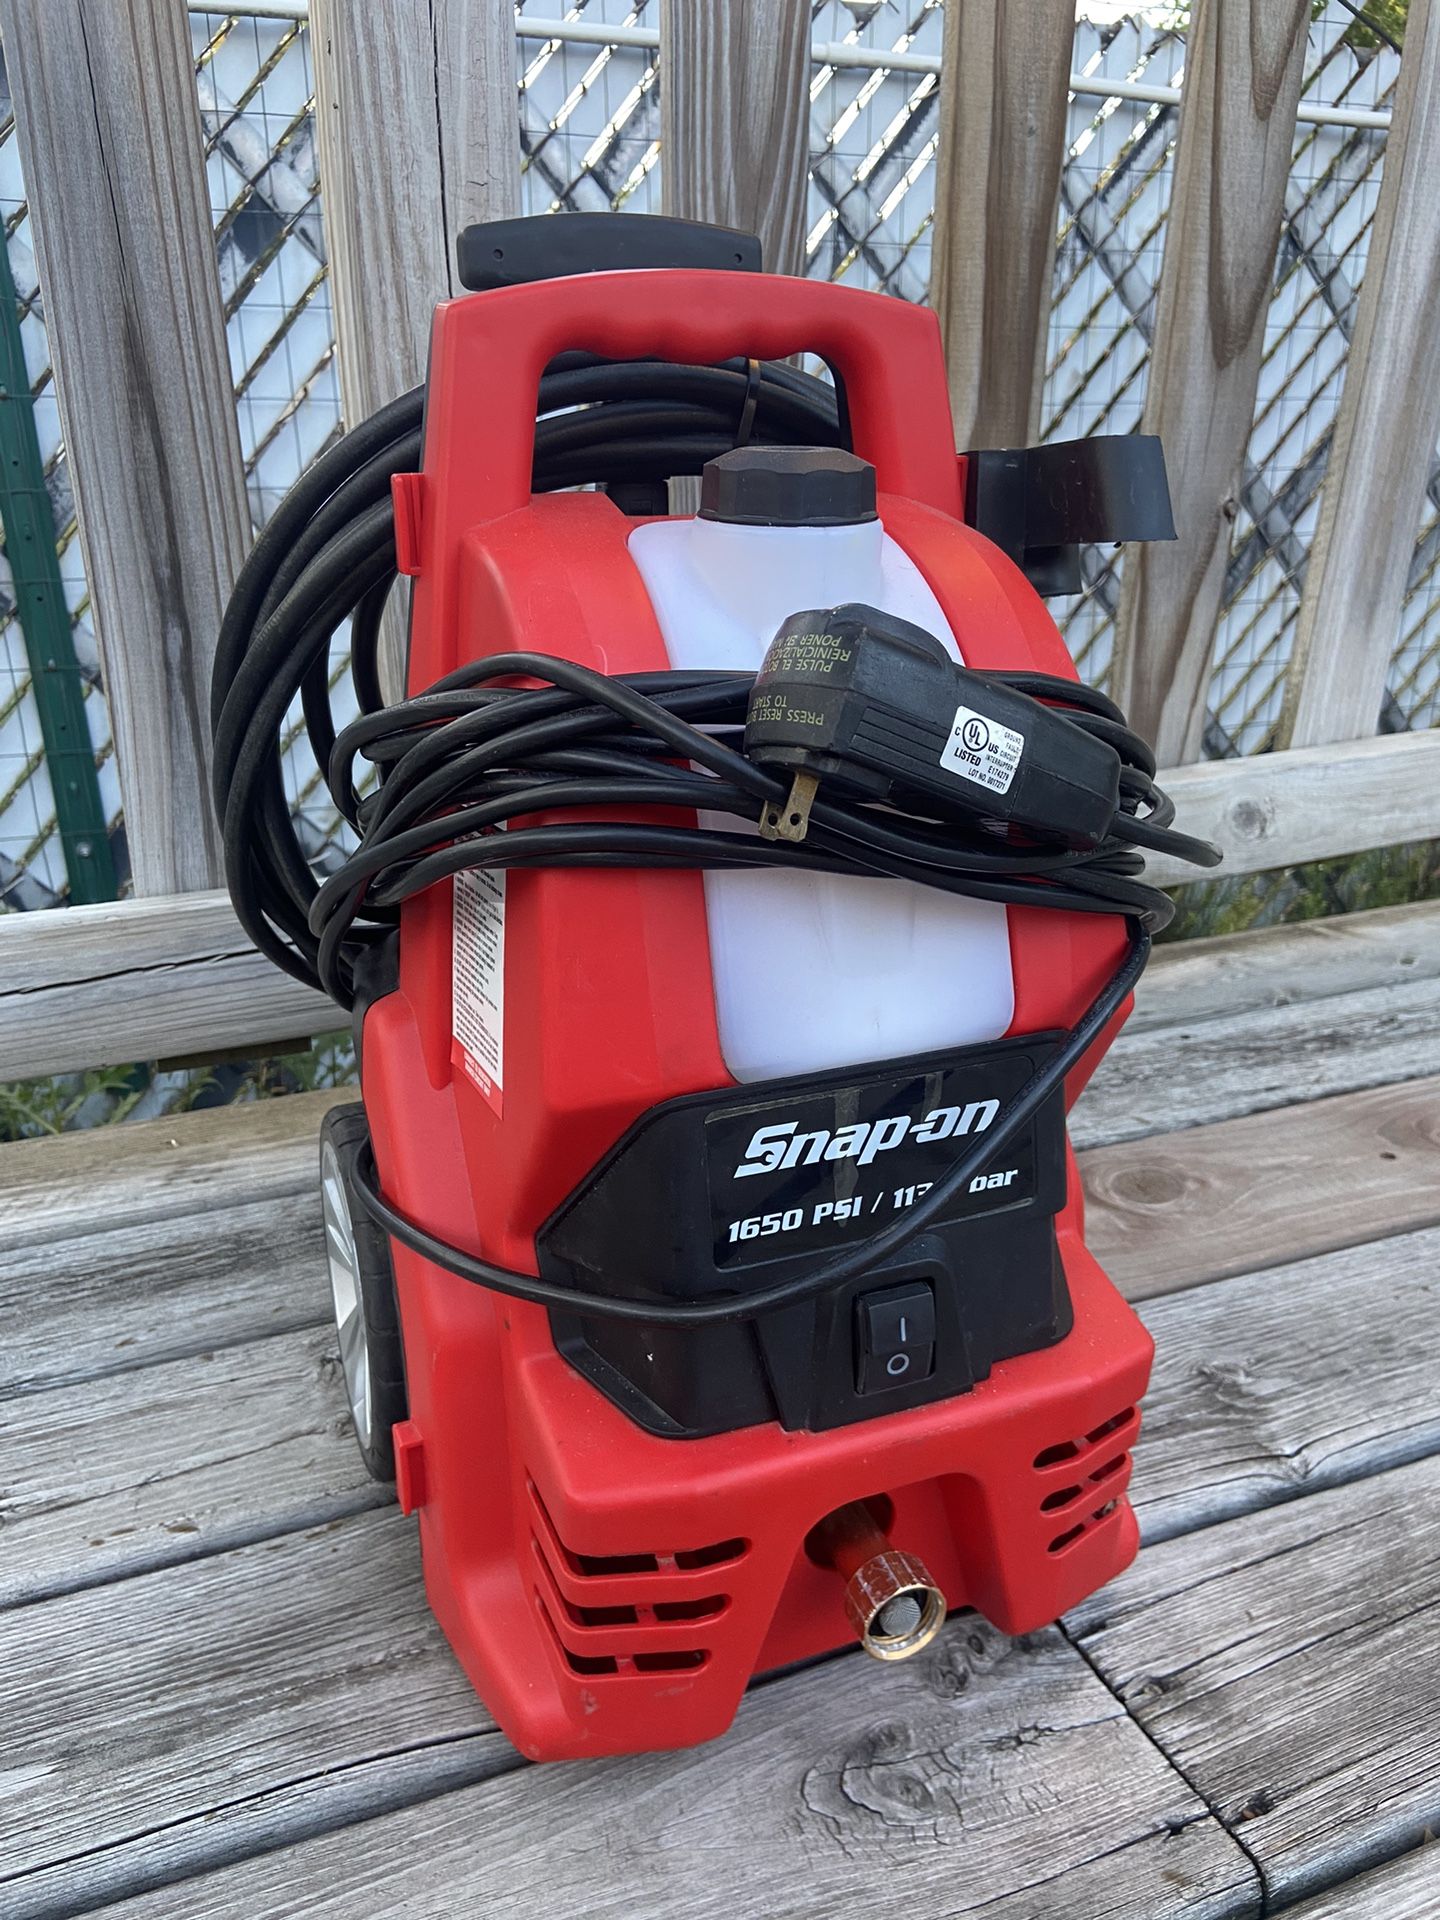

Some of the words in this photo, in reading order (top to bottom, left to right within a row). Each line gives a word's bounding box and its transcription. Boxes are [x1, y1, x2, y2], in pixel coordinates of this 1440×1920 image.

[800, 634, 842, 647] PONER
[782, 659, 792, 670] EL
[795, 659, 834, 672] PULSE
[774, 695, 787, 708] TO
[758, 708, 782, 721] RESET
[787, 709, 824, 726] PRESS
[987, 742, 999, 754] US
[954, 747, 982, 767] LISTED
[985, 754, 1014, 772] INTERRUPTER
[968, 768, 979, 778] LOT
[733, 1099, 1001, 1179] Snap-on
[728, 1208, 804, 1243] 1650
[812, 1196, 863, 1226] PSI
[870, 1191, 885, 1214] /
[968, 1169, 1019, 1193] bar
